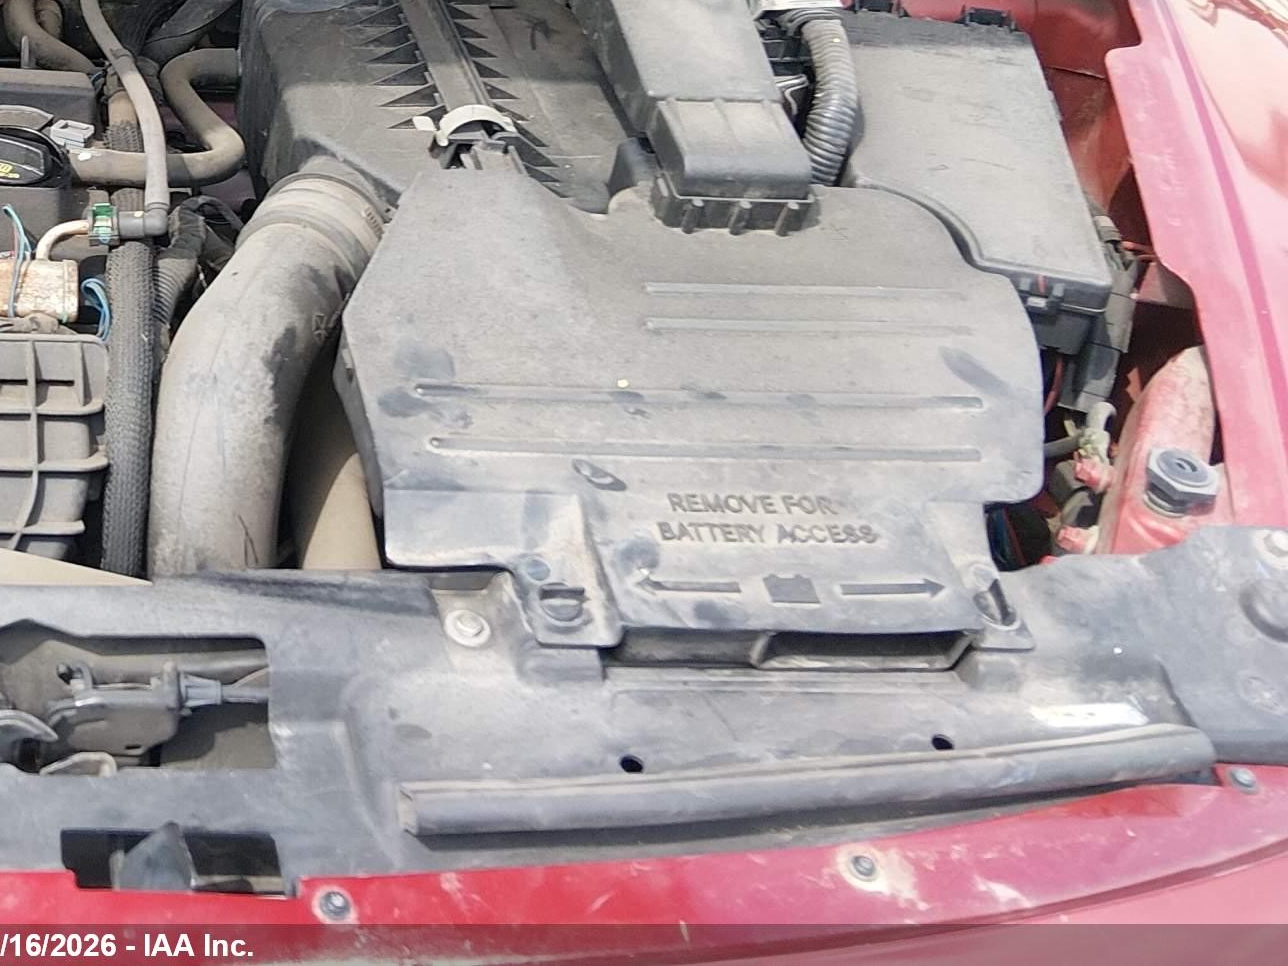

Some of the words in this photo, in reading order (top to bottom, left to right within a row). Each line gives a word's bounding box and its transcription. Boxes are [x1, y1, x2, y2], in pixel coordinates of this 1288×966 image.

[667, 493, 777, 515] REMOVE
[782, 495, 838, 515] FOR
[656, 521, 765, 543] BATTERY
[777, 524, 878, 544] ACCESS
